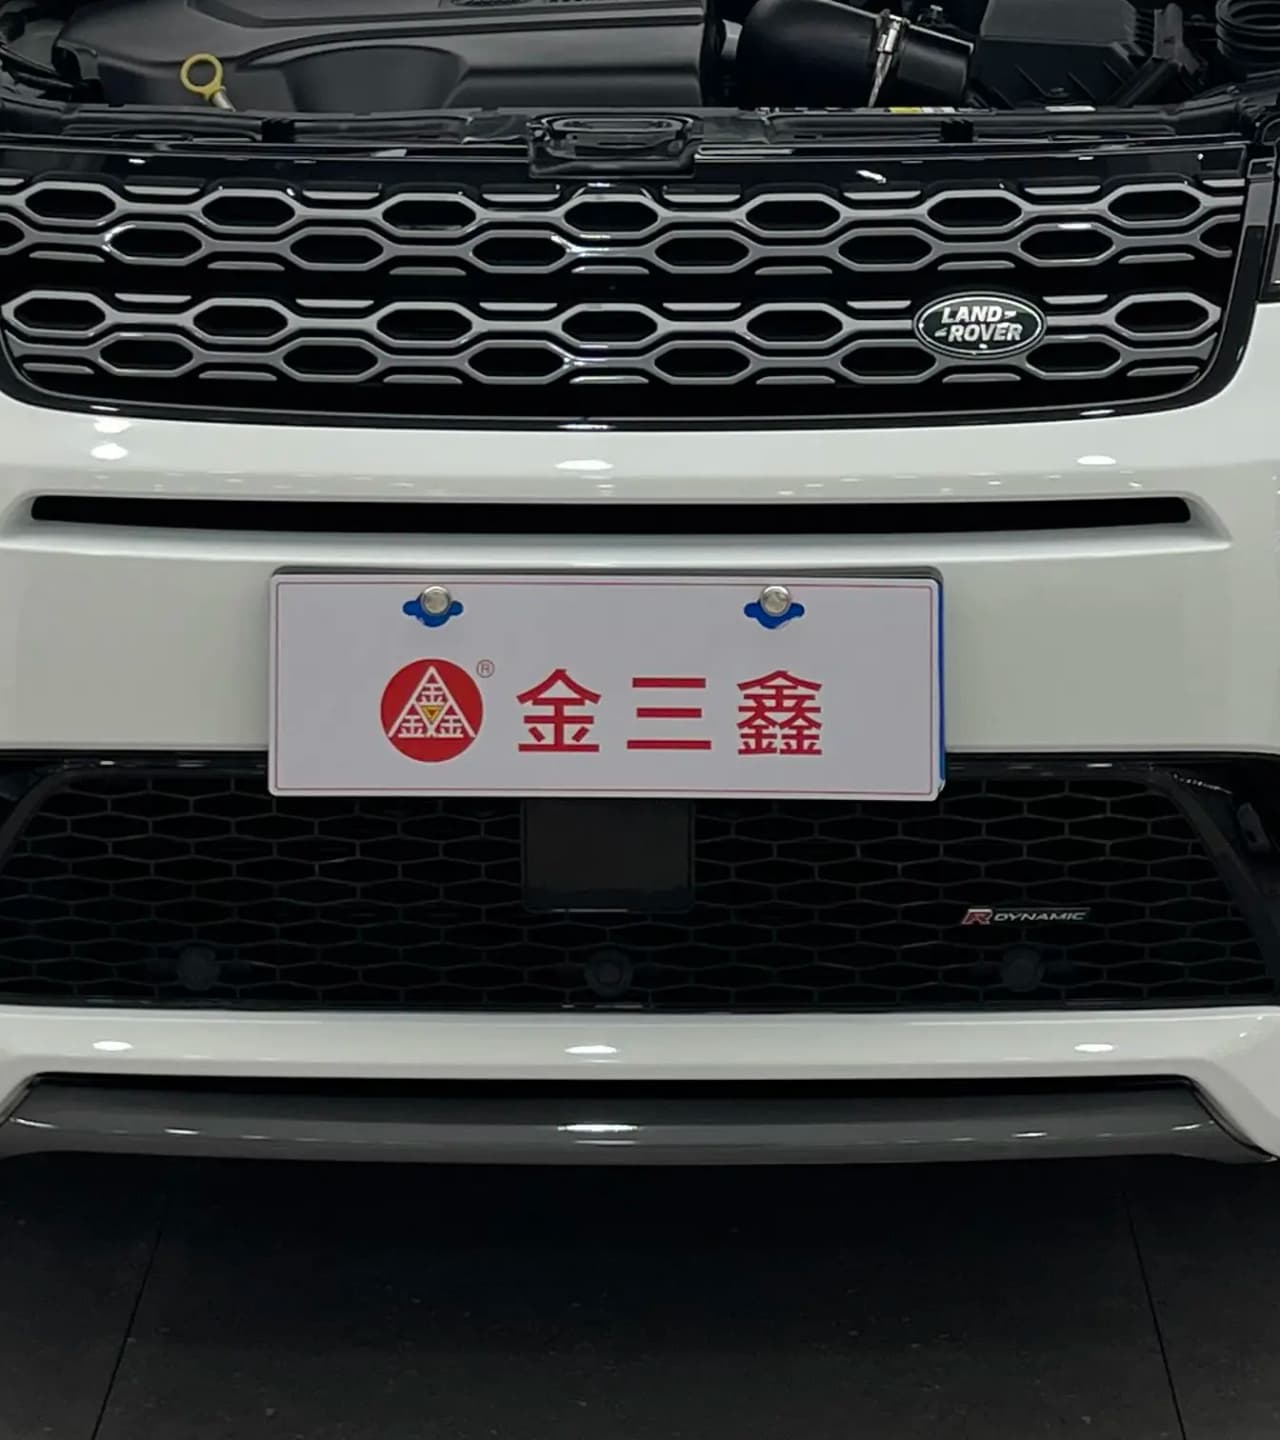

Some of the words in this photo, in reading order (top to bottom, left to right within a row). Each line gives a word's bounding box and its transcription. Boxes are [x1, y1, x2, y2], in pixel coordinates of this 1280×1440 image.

[941, 306, 1002, 324] LAND
[947, 322, 1023, 342] ROVER
[516, 668, 823, 756] 金三鑫
[994, 912, 1086, 921] DYNAMIC
